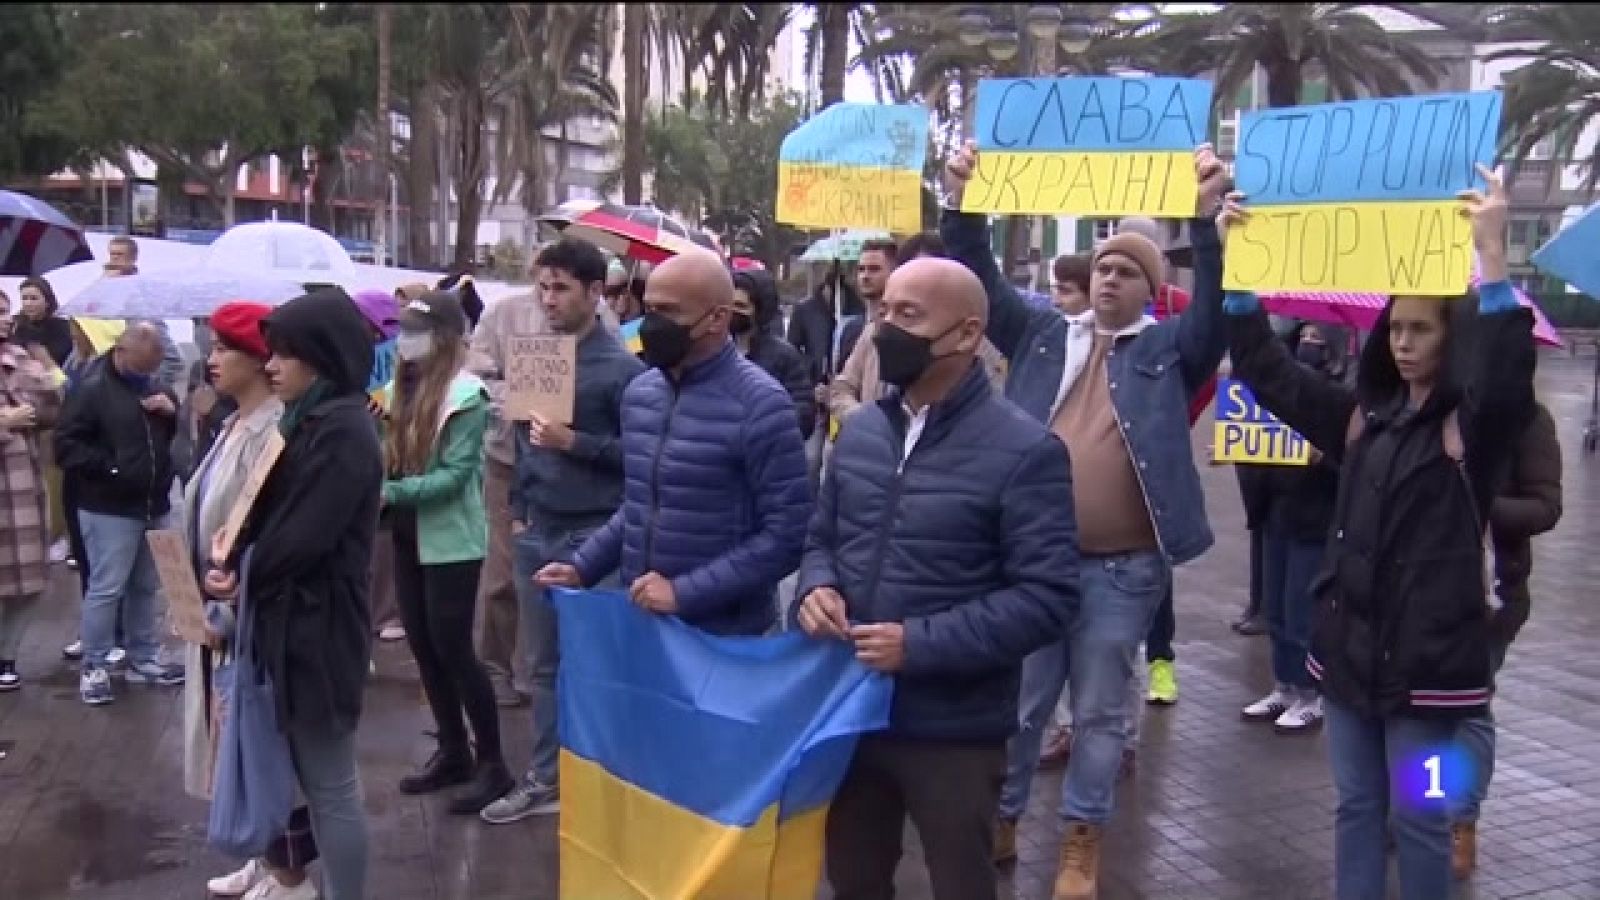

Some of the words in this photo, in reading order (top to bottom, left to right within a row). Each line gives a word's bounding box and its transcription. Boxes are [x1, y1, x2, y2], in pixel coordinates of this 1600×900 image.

[991, 78, 1197, 148] СЛАВА
[1244, 107, 1353, 196] STOP
[1357, 95, 1496, 191] PUTIN
[1234, 207, 1360, 287] STOP
[1381, 206, 1472, 289] WAR
